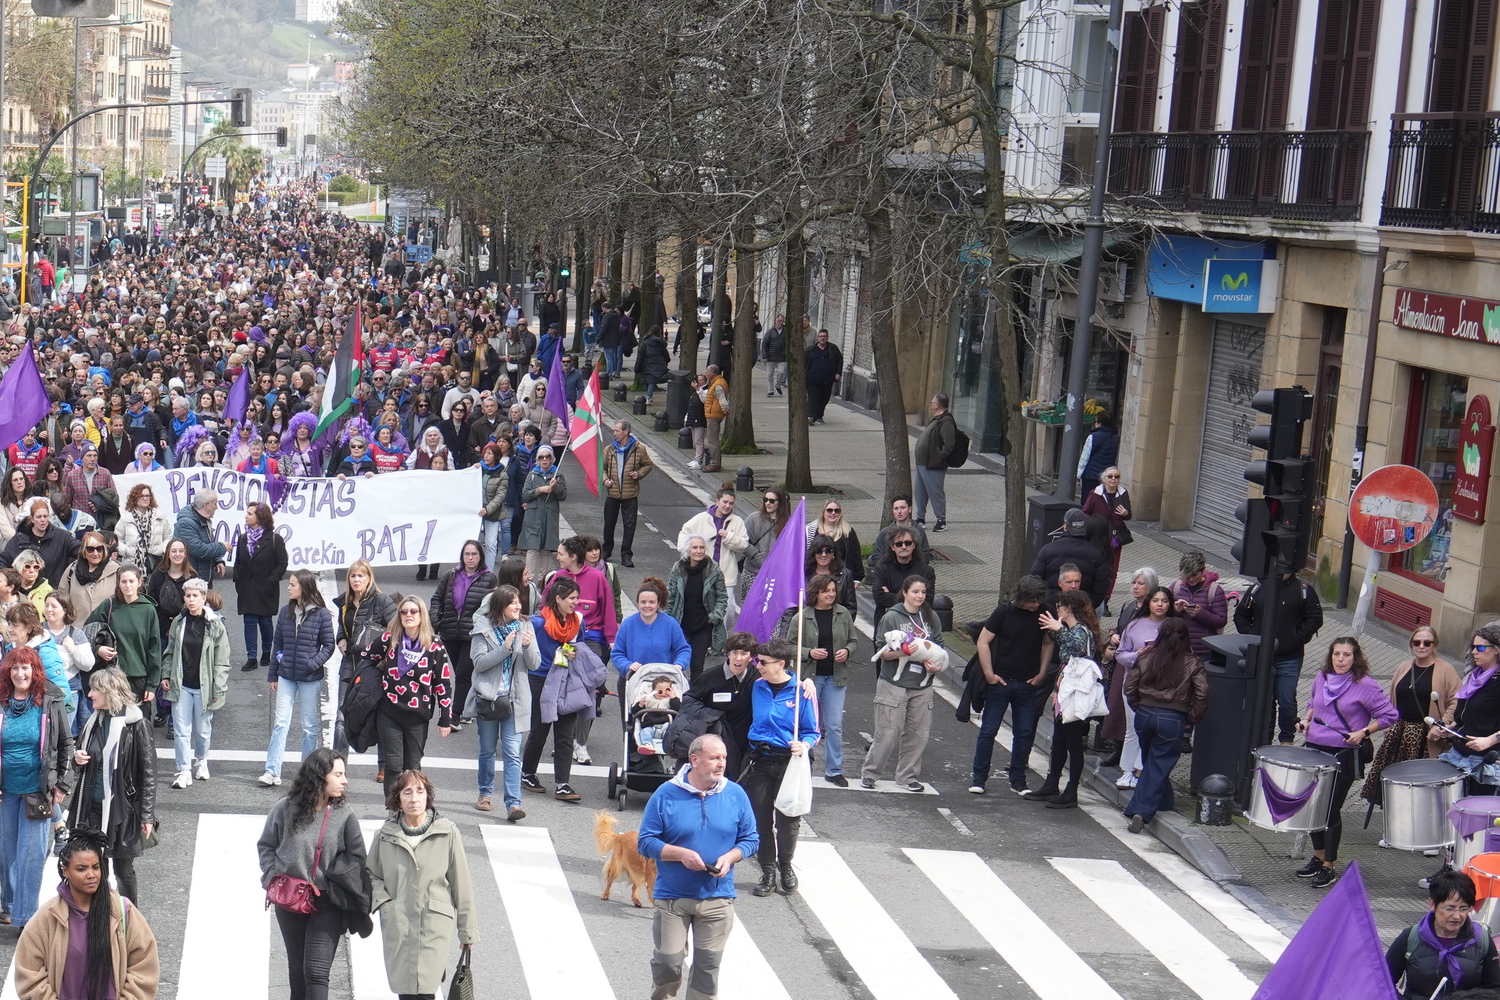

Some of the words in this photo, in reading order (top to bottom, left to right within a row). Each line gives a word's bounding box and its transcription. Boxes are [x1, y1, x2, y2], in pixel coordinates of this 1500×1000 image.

[1394, 291, 1445, 334] Alimentación
[1452, 299, 1479, 340] Sana
[1466, 453, 1481, 477] holi
